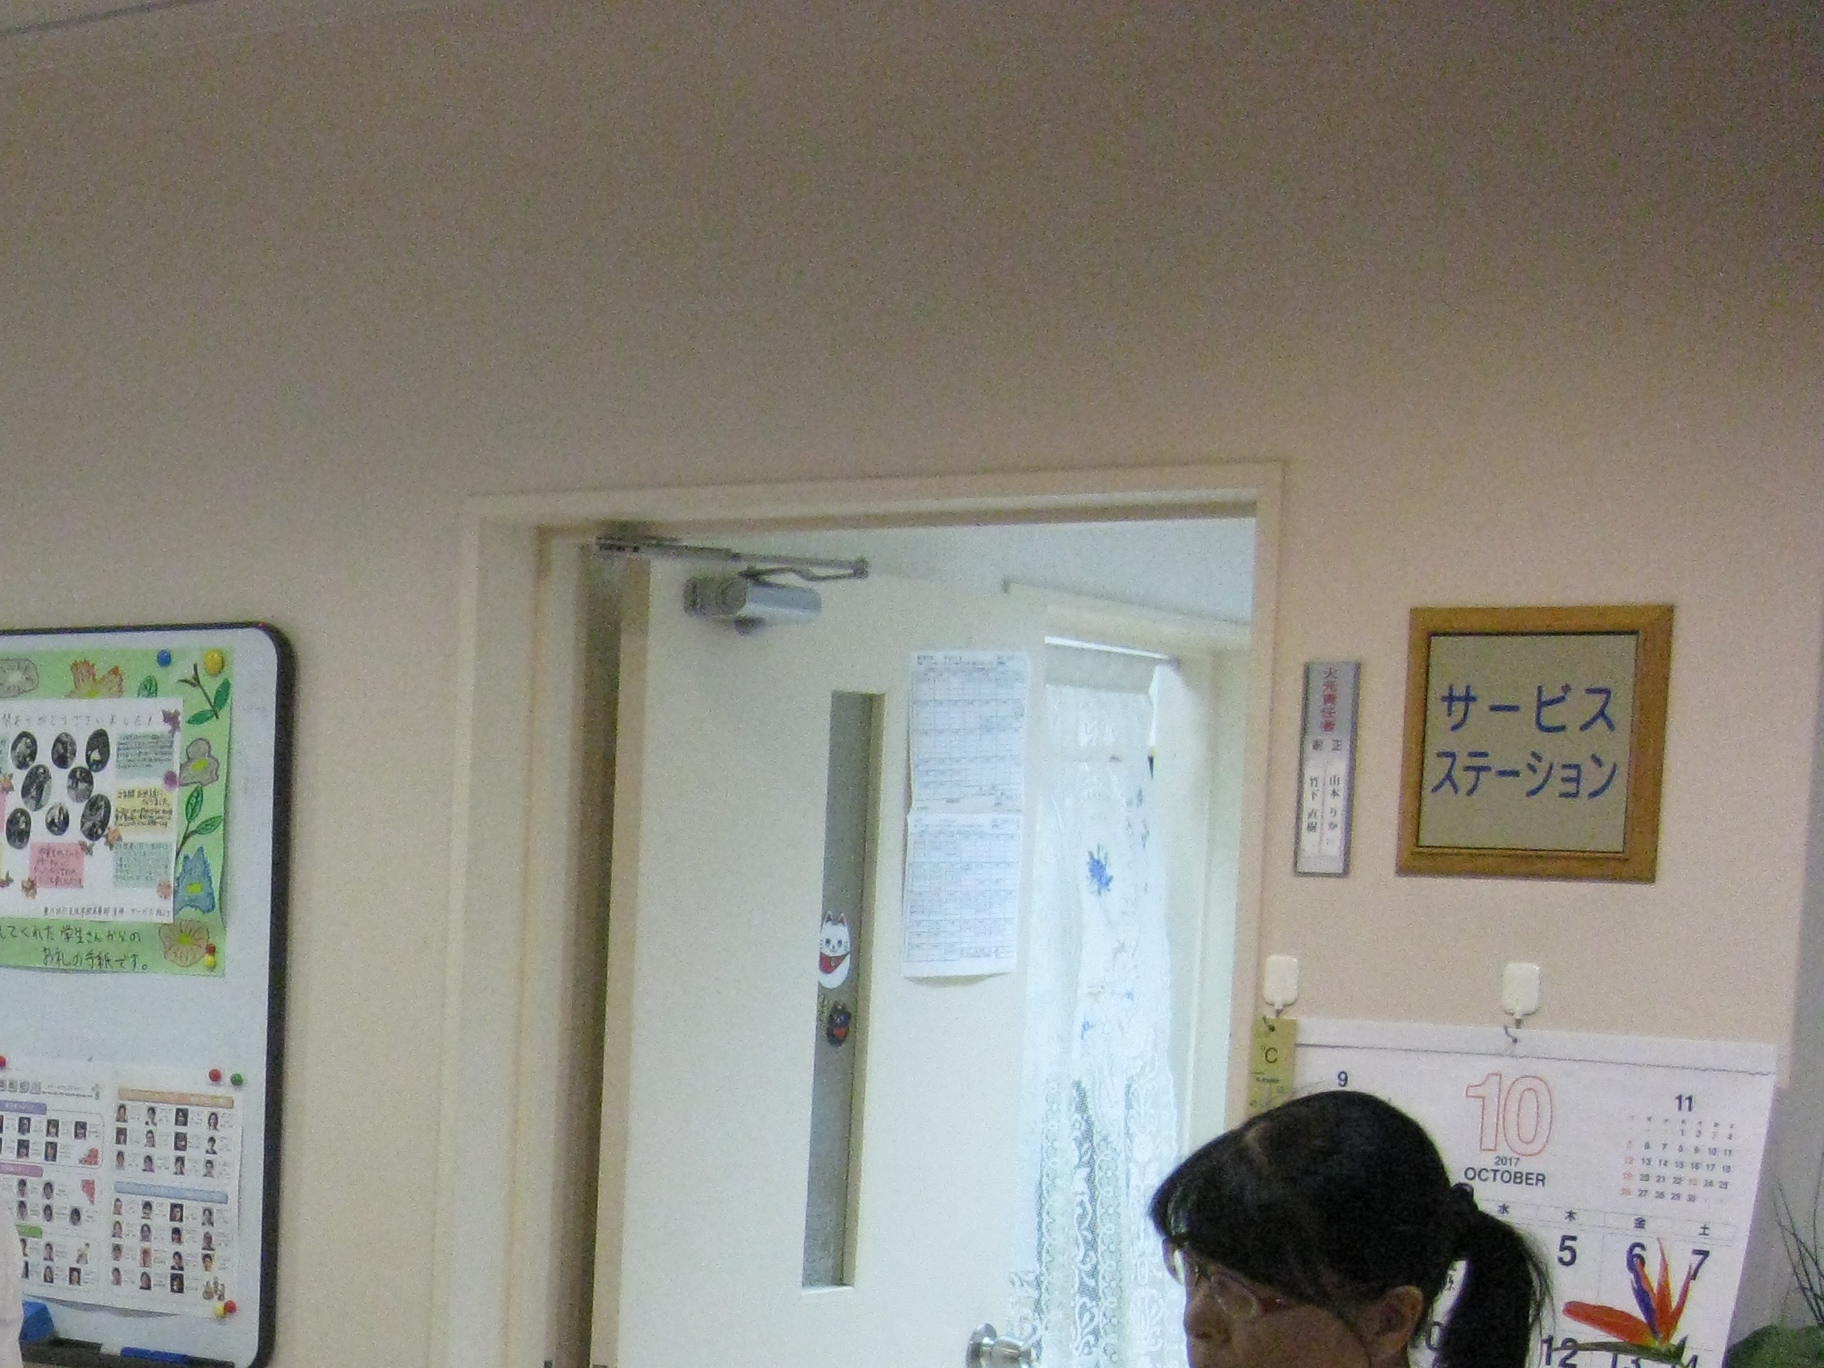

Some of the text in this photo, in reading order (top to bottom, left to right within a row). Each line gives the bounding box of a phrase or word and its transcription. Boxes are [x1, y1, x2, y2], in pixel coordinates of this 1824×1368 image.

[1440, 682, 1616, 734] サービス
[1431, 750, 1617, 800] ステーション
[1337, 1070, 1349, 1088] 9
[1465, 1071, 1554, 1157] 10
[1675, 1093, 1694, 1112] 11
[1494, 1155, 1520, 1168] 2017
[1463, 1167, 1547, 1189] OCTOBER
[1564, 1210, 1577, 1223] 木
[1633, 1216, 1647, 1230] 金
[1698, 1224, 1710, 1237] 土
[1557, 1235, 1577, 1267] 5
[1690, 1249, 1710, 1281] 7
[1541, 1334, 1578, 1368] 12
